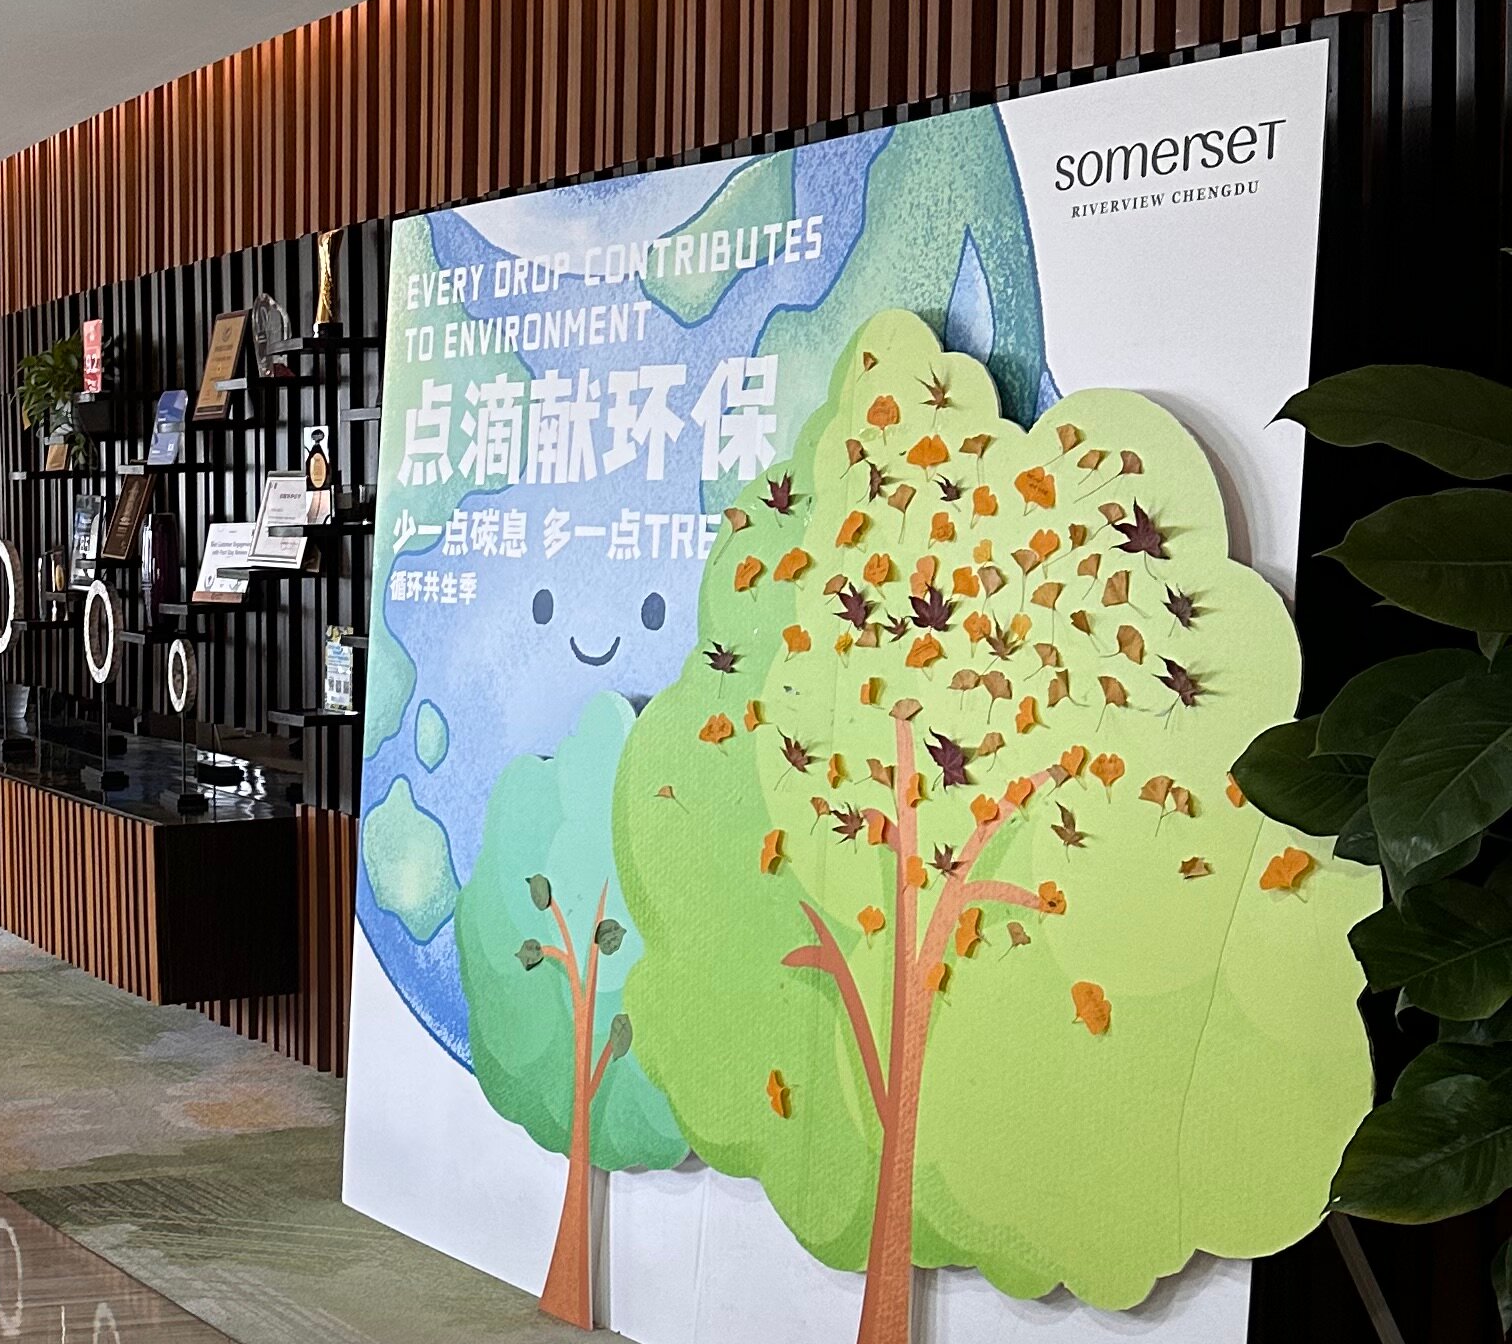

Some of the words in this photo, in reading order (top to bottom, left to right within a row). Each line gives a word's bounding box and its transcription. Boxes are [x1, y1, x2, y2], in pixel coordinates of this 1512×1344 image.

[1071, 193, 1166, 219] RIVERVIEW
[1172, 180, 1260, 205] CHENGDU
[407, 263, 485, 311] EVERY
[494, 253, 571, 299] DROP
[584, 215, 824, 287] CONTRIBUTES
[405, 327, 434, 363] TO
[444, 301, 653, 359] ENVIRONMENT
[397, 354, 780, 487] 点滴献环保
[392, 507, 528, 558] 少一点碳息
[389, 570, 478, 606] 循环共生季
